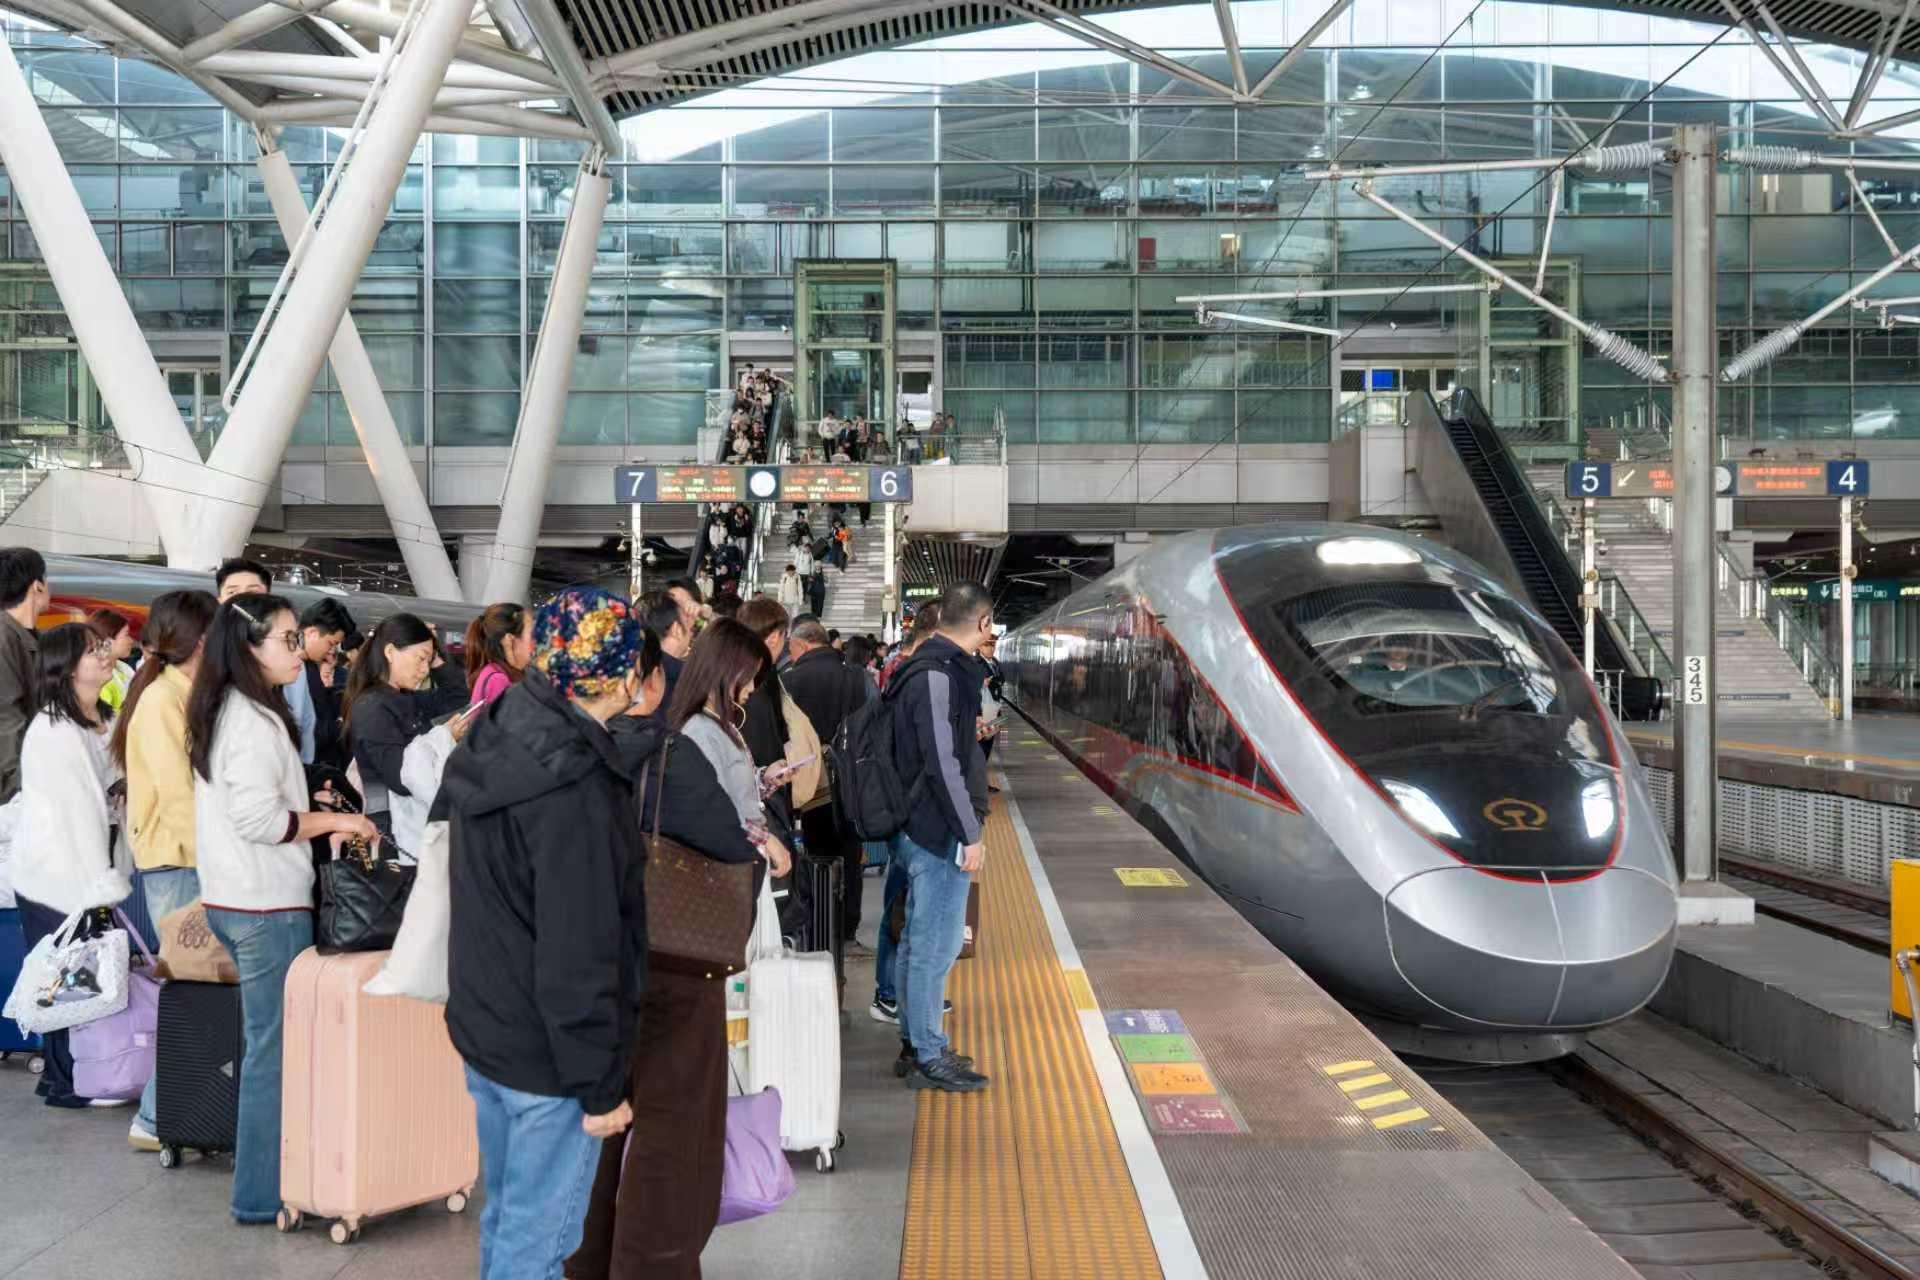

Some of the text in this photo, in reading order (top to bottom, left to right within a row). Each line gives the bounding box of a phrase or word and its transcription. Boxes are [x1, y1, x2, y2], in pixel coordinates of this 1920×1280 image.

[628, 472, 645, 497] 7
[880, 471, 898, 496] 6
[1581, 467, 1599, 492] 5
[1838, 465, 1857, 491] 4
[1688, 657, 1703, 703] 345
